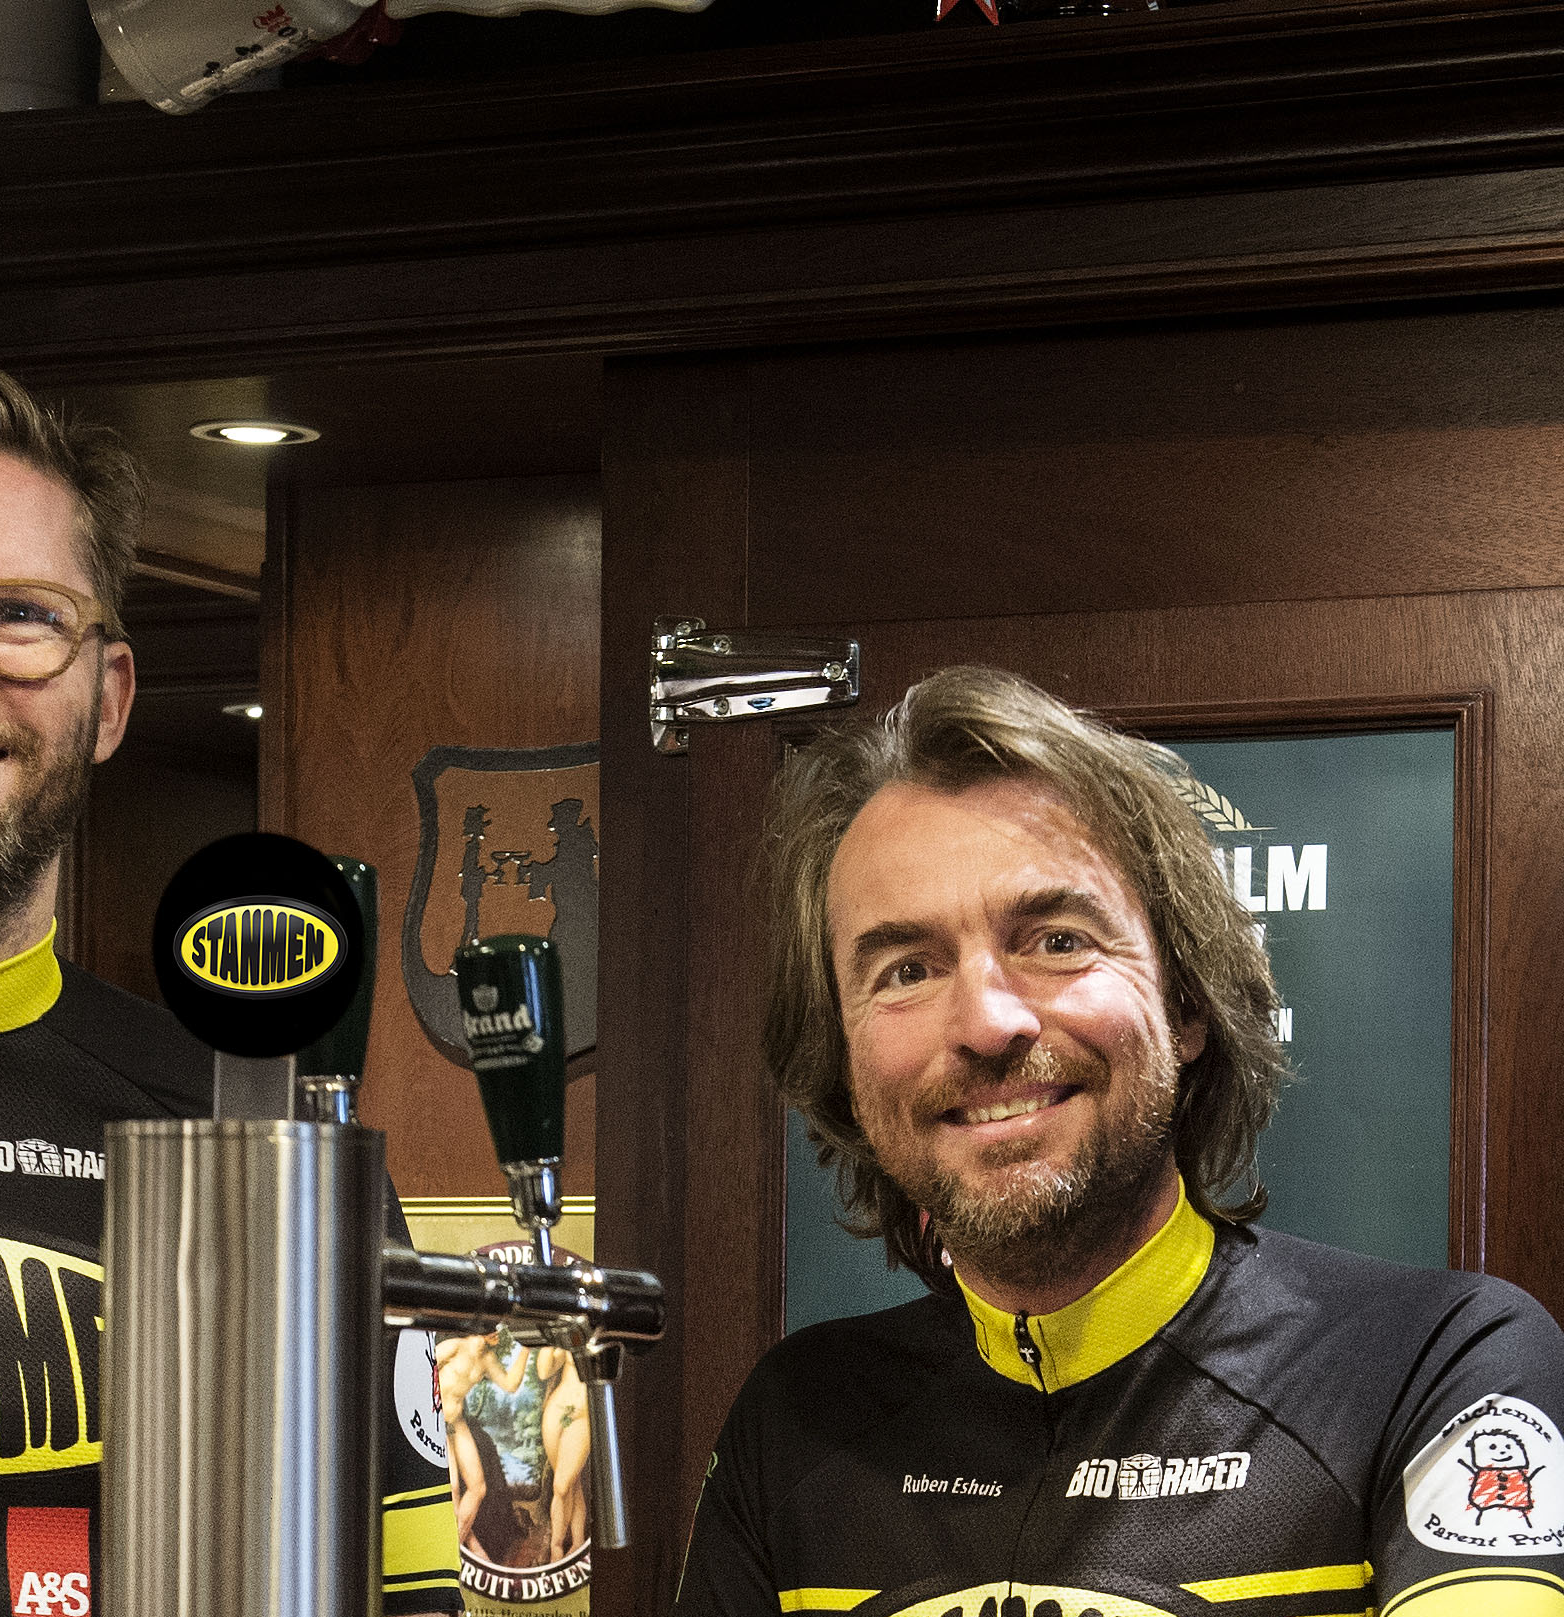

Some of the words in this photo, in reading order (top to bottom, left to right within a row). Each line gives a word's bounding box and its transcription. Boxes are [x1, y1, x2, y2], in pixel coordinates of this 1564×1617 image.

[191, 908, 325, 987] STANMEN
[903, 1474, 947, 1495] Ruben
[951, 1477, 1003, 1498] Eshuis
[1161, 1451, 1251, 1496] RACER
[1424, 1513, 1498, 1548] Parent
[14, 1571, 91, 1617] A&S
[460, 1560, 514, 1600] RUIT
[521, 1553, 591, 1600] DÉFEN
